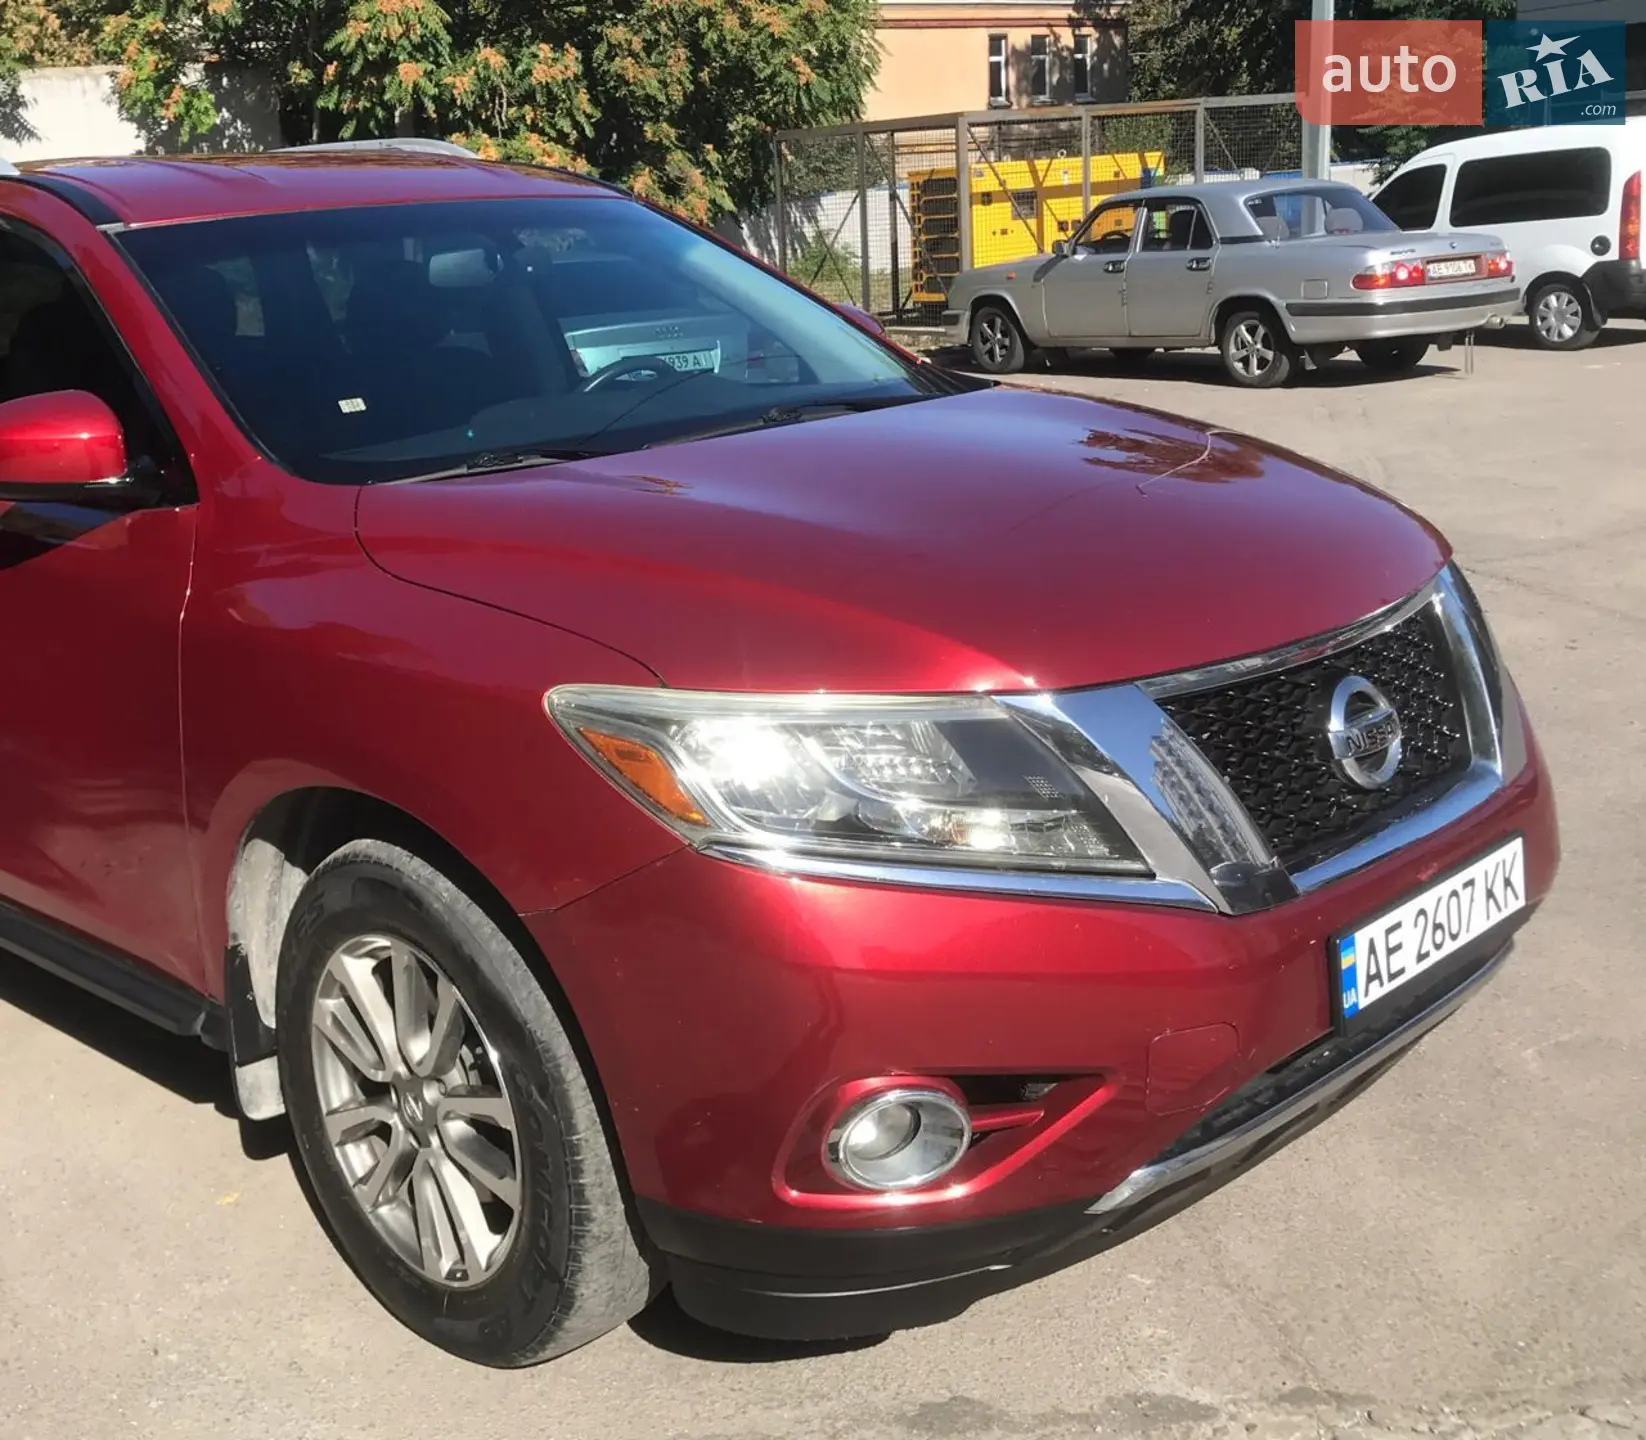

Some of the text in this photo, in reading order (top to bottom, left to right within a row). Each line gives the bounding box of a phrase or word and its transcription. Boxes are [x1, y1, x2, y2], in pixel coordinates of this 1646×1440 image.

[664, 355, 689, 369] 939
[1347, 720, 1397, 755] NISSA
[1363, 851, 1520, 999] AE 2607 KK
[1342, 990, 1358, 1009] UA
